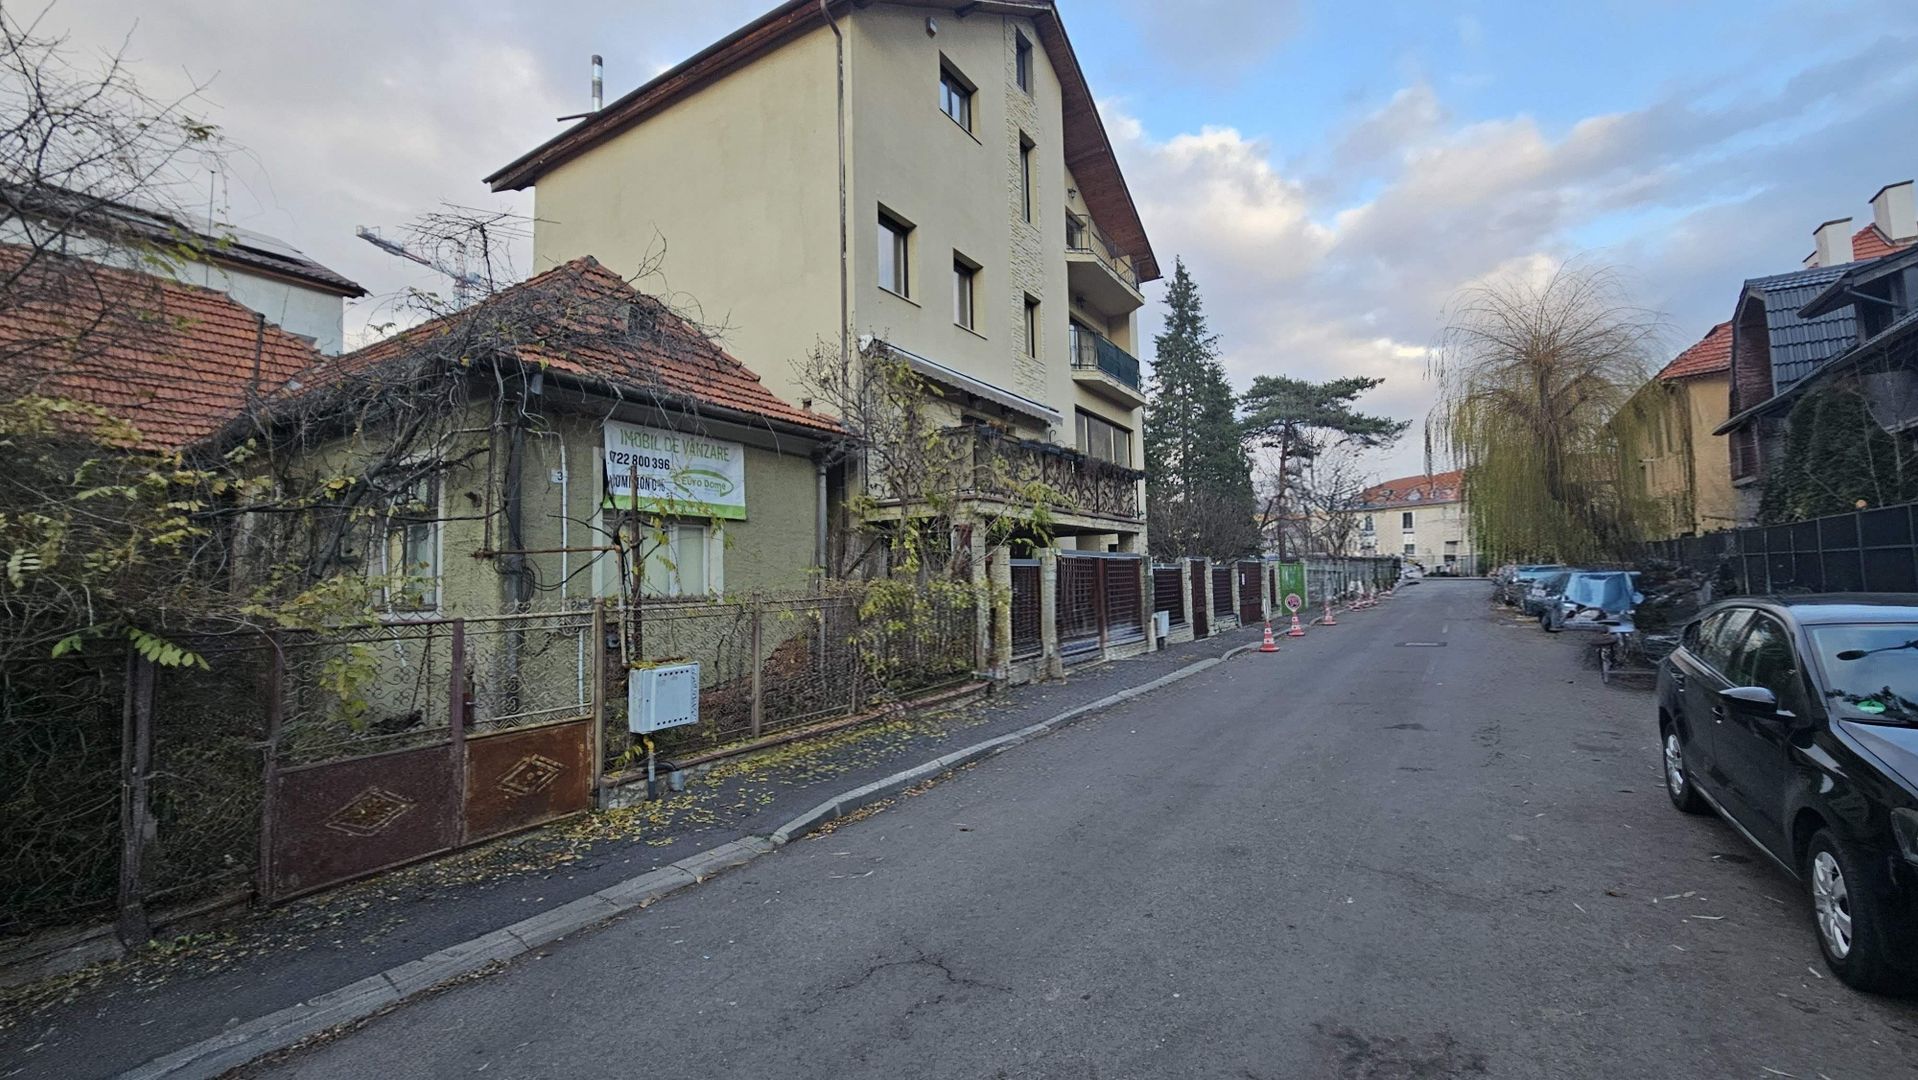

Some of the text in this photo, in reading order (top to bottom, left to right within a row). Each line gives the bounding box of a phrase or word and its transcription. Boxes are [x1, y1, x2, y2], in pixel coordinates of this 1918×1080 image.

[620, 428, 661, 451] IMOBIL
[664, 436, 680, 453] DE
[609, 450, 670, 470] 0722 800 396
